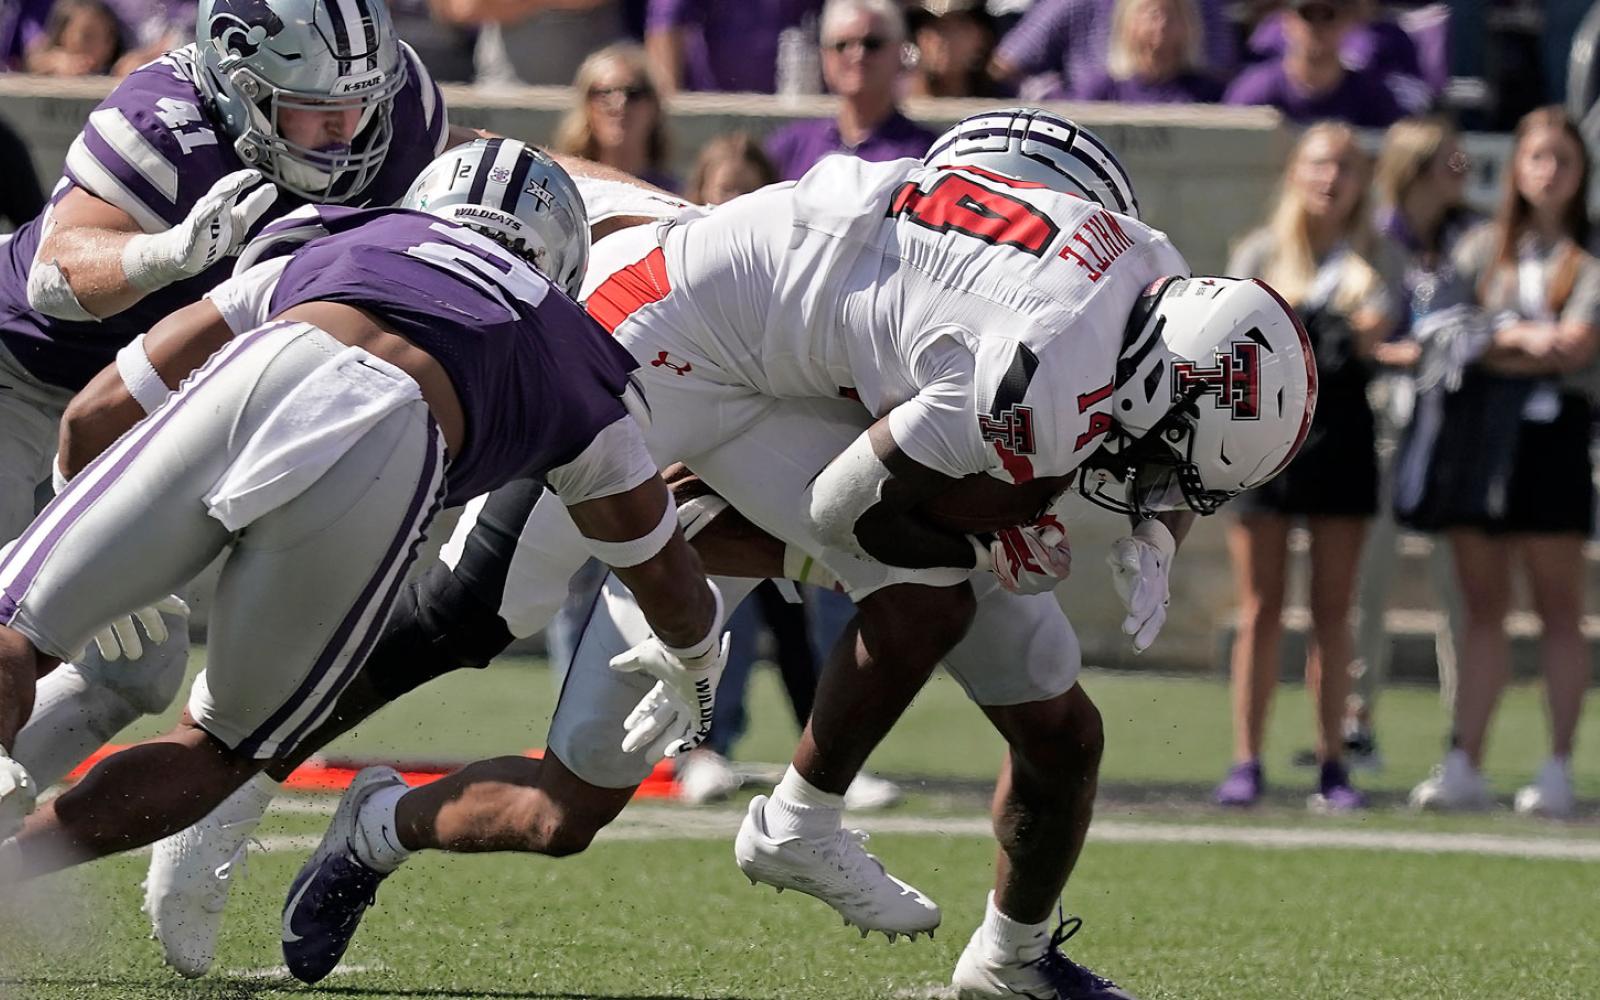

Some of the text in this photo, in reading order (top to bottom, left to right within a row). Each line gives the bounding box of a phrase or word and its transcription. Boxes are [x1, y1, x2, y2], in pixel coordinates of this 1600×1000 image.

[343, 75, 382, 92] K-STATE
[155, 97, 218, 155] 41
[454, 207, 522, 231] WILDCATS
[1058, 209, 1135, 283] WHITE
[1072, 375, 1115, 454] 14
